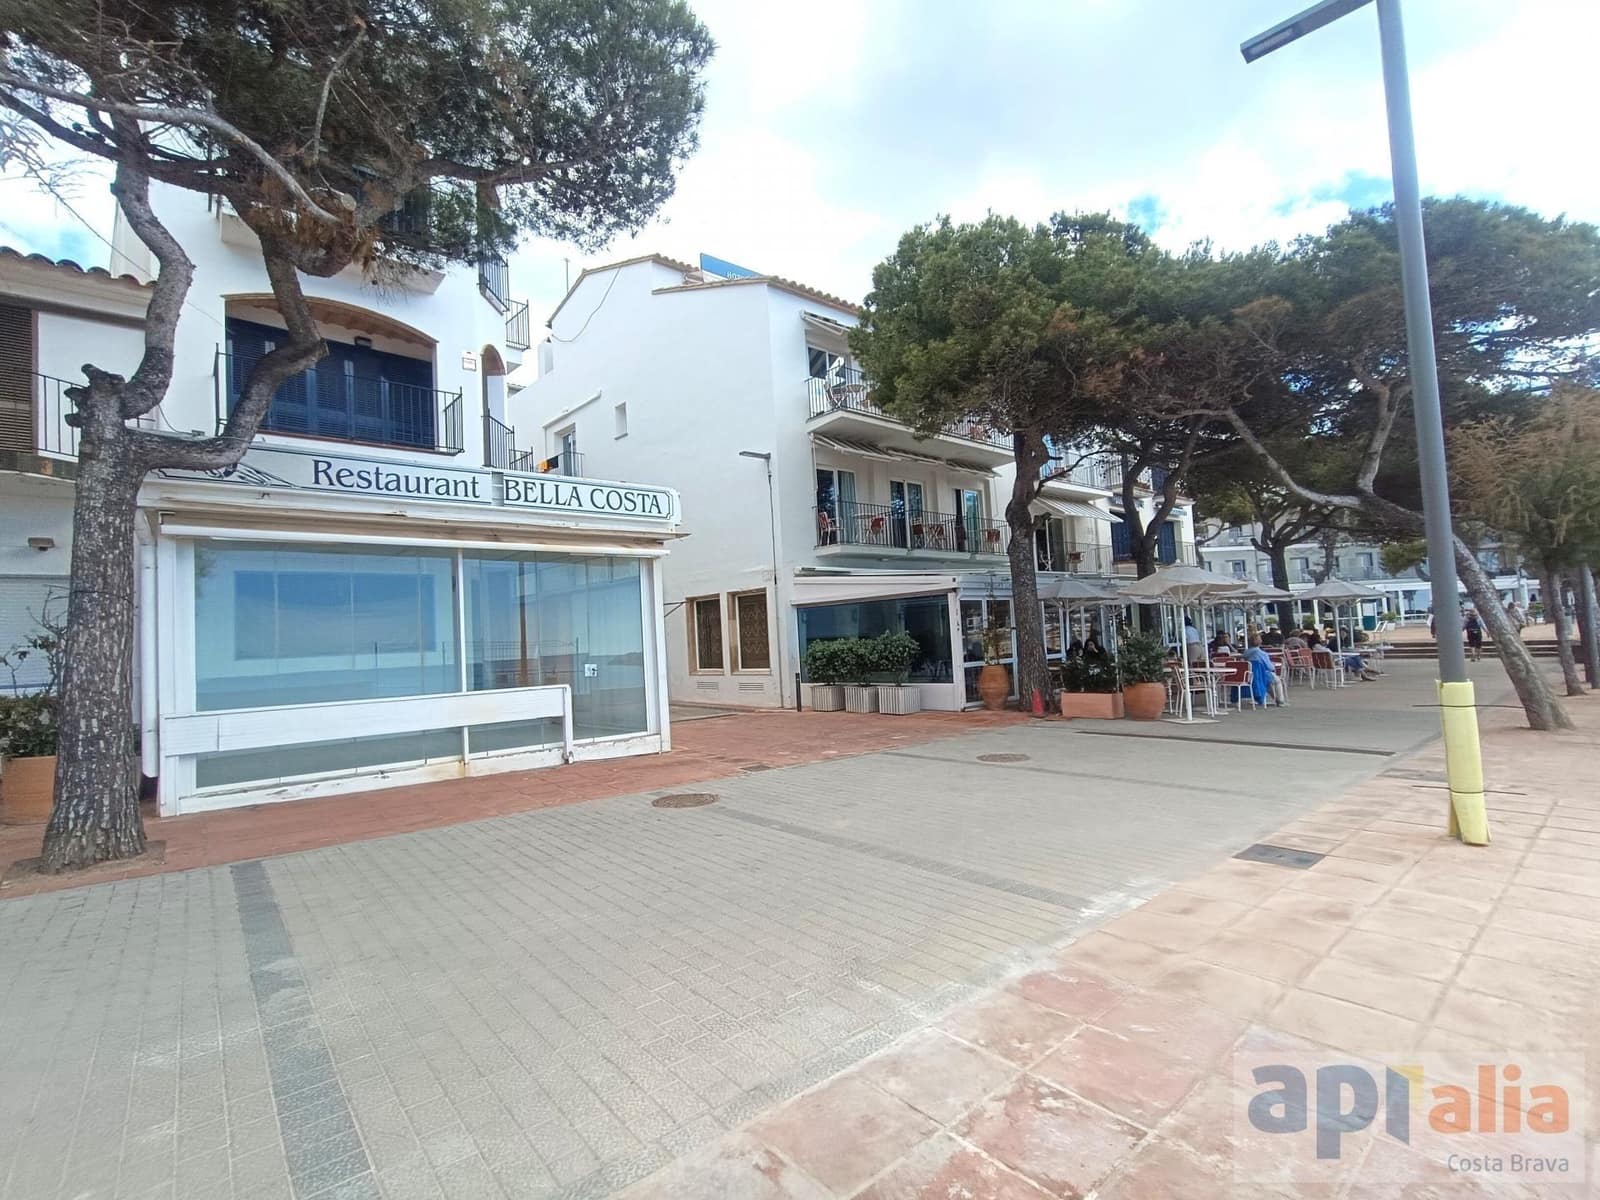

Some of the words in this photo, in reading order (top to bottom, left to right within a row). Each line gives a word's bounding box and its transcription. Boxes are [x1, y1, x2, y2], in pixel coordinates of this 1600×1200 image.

[312, 459, 480, 499] Restaurant
[504, 479, 583, 507] BELLA
[590, 488, 662, 514] COSTA
